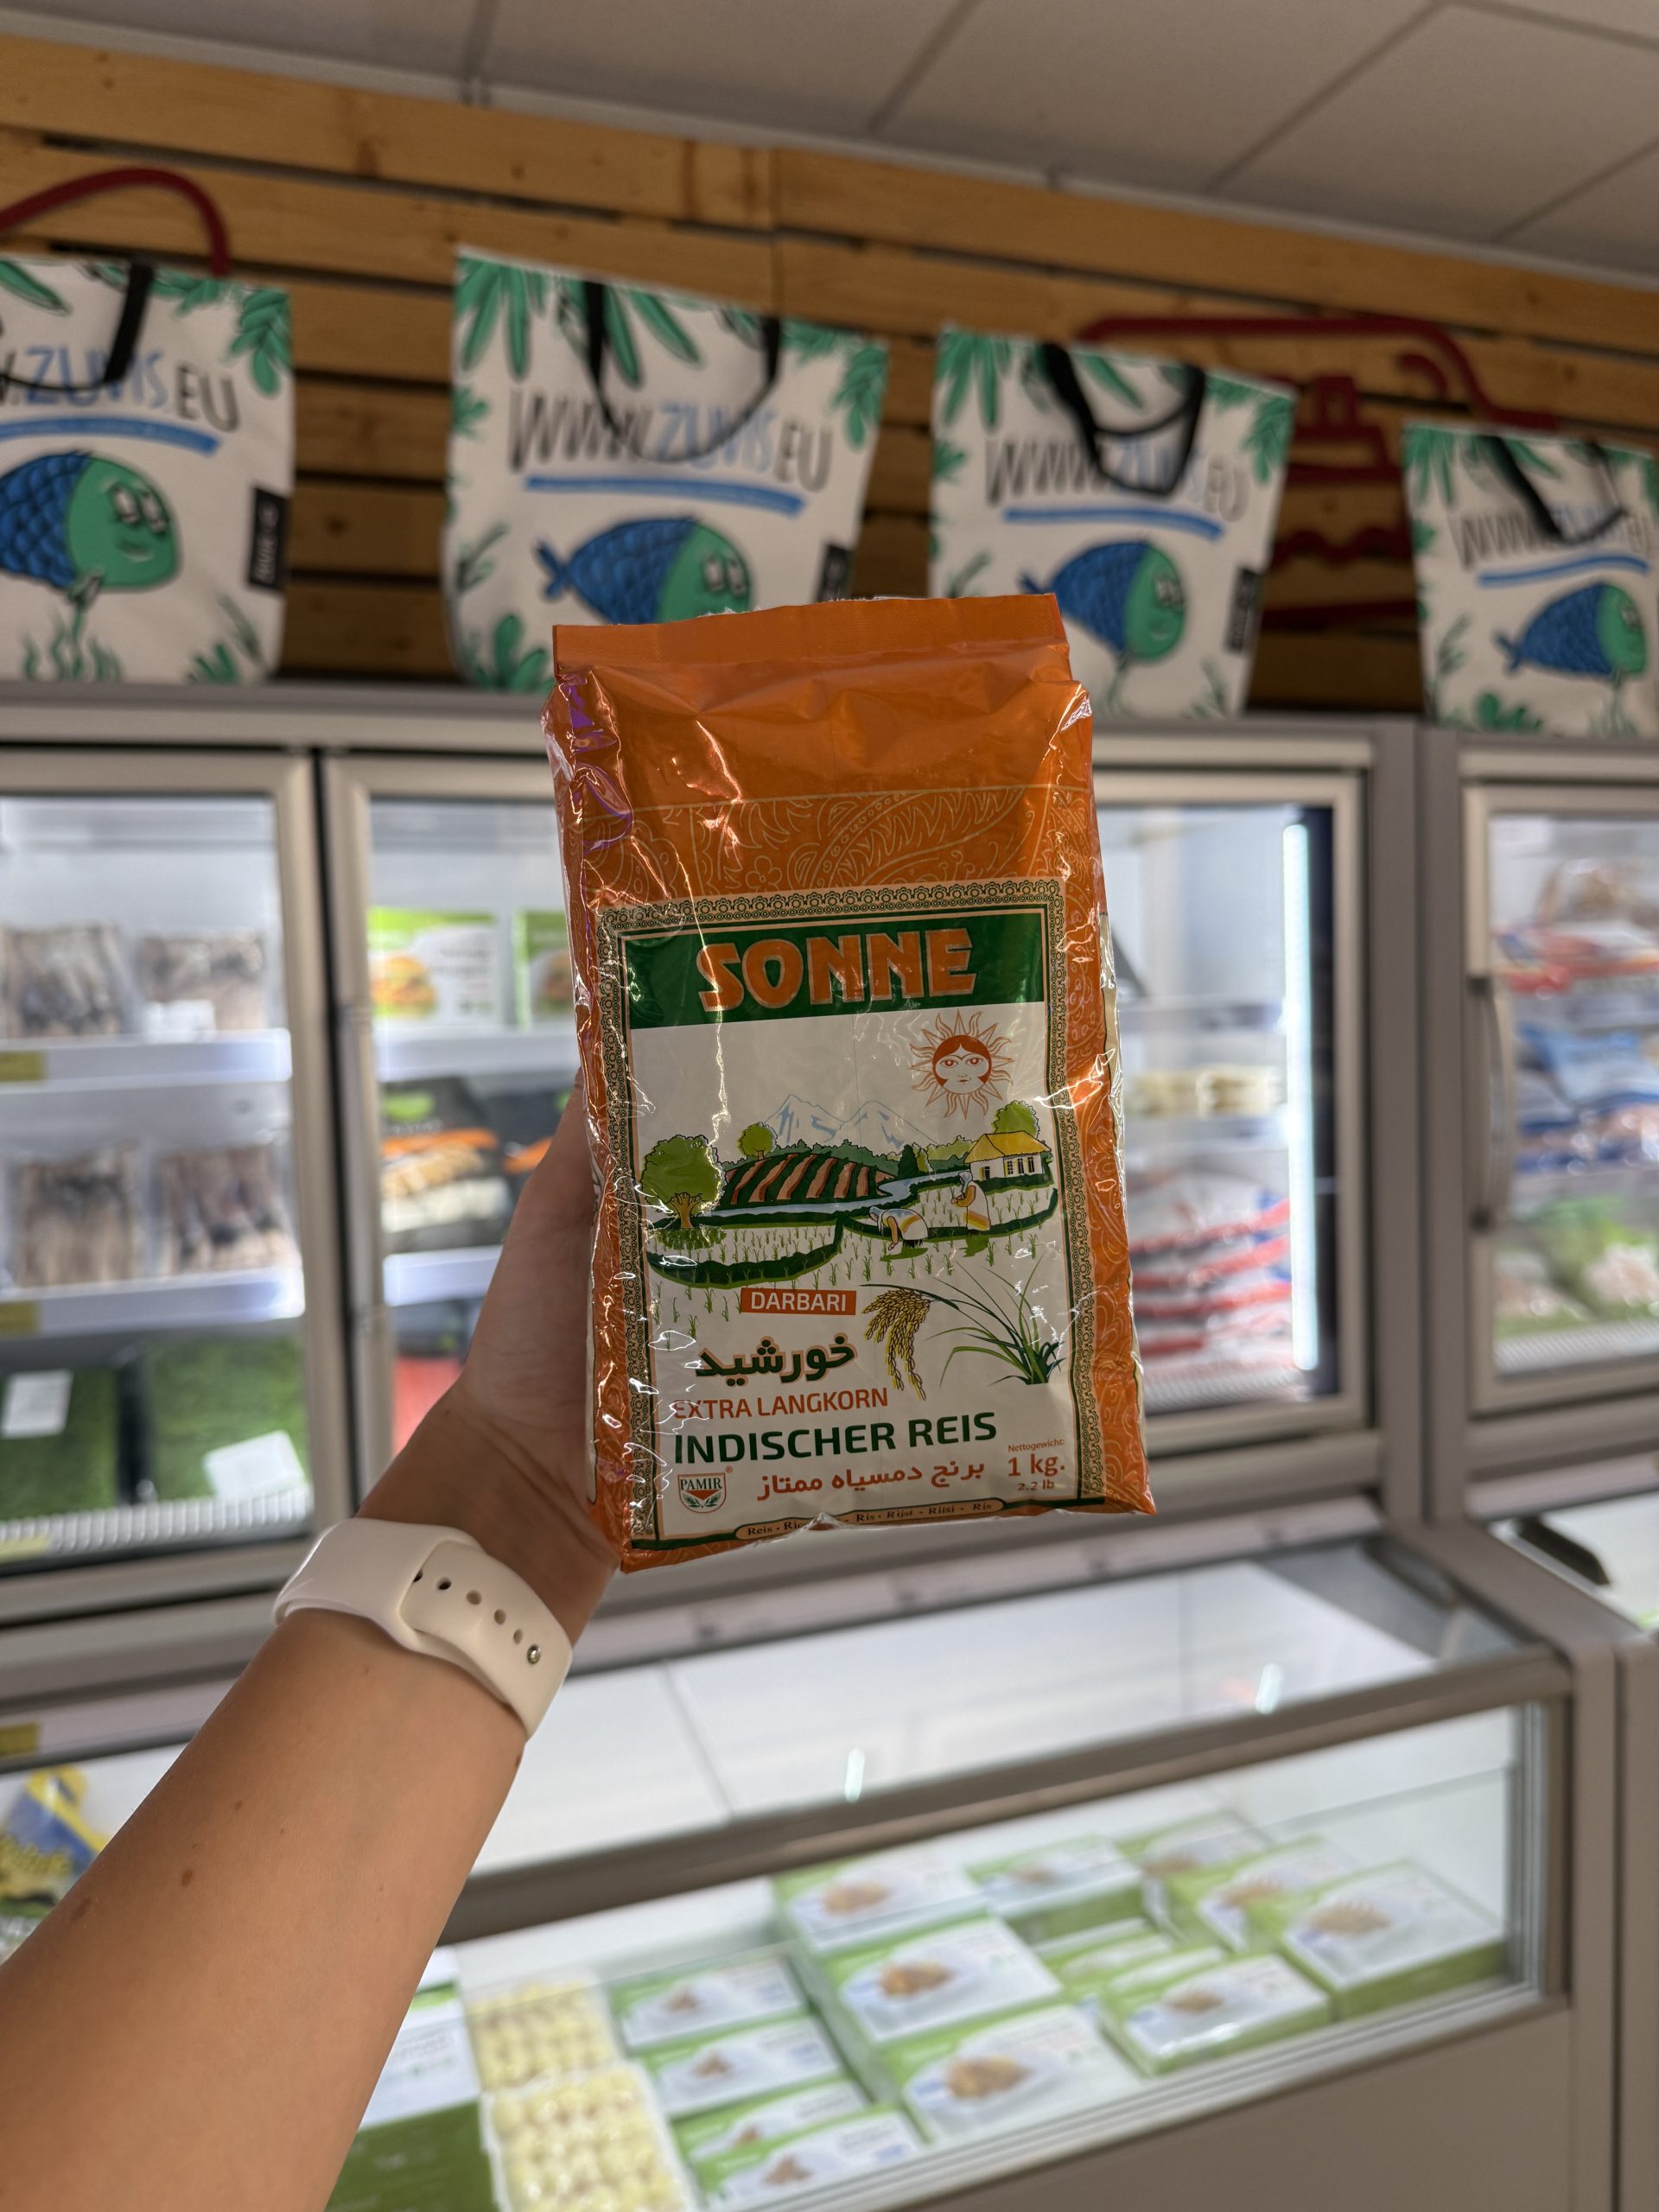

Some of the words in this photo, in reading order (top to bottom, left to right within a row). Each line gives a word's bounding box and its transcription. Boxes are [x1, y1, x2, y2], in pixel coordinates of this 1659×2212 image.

[696, 927, 976, 1013] SONNE
[750, 1292, 847, 1312] DARBARI
[694, 1332, 858, 1387] خورشید
[673, 1398, 753, 1420] EXTRA
[757, 1387, 889, 1416] LANGKORN
[674, 1422, 896, 1465] INDISCHER
[908, 1411, 997, 1447] REIS
[1007, 1438, 1065, 1452] Nettogewicht:
[1007, 1456, 1021, 1477] 1
[1030, 1452, 1065, 1478] kg.
[680, 1477, 724, 1491] PAMIR
[756, 1474, 823, 1502] ممتاز
[1017, 1482, 1037, 1491] 2.2
[1042, 1478, 1056, 1491] lb
[747, 1526, 773, 1536] Reis
[856, 1513, 875, 1522] Ris
[973, 1502, 993, 1510] Ris
